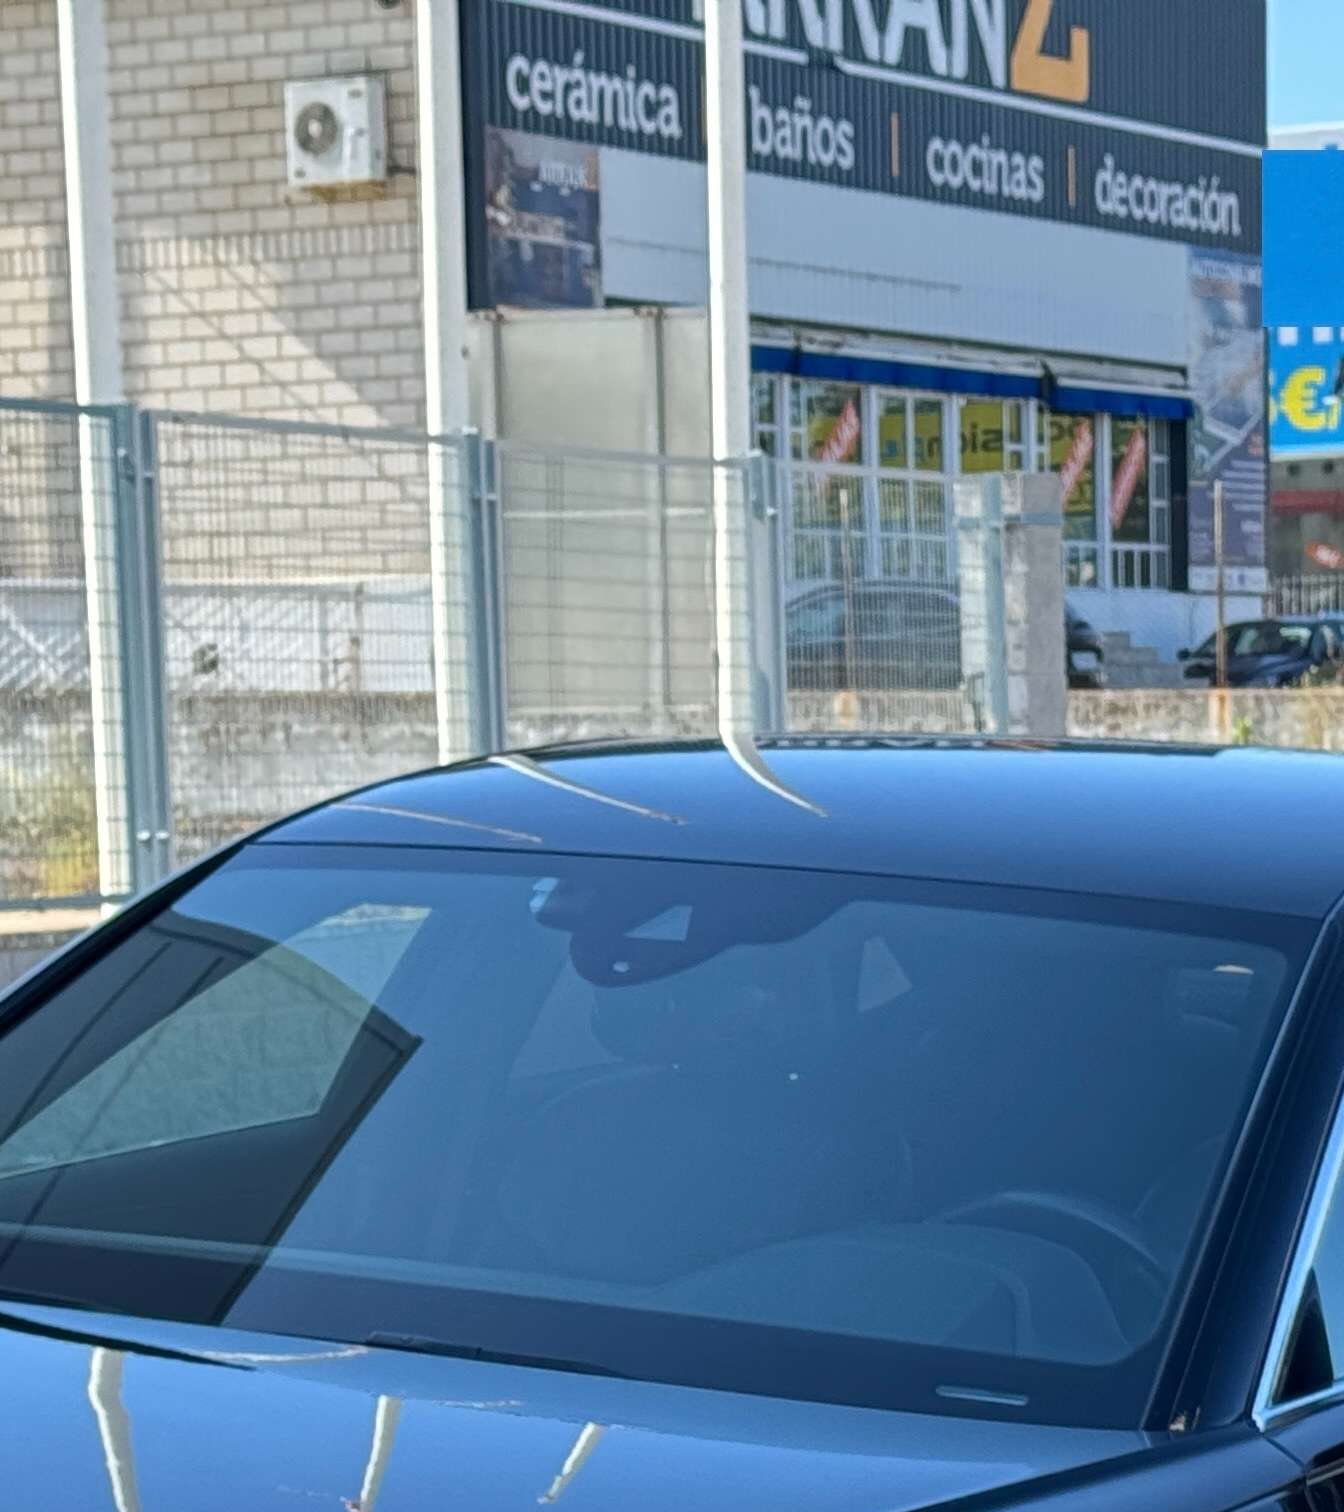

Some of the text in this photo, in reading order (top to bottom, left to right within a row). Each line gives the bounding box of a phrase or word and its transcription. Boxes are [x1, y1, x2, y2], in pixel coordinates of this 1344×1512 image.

[693, 0, 1090, 102] ANZ
[506, 50, 1242, 236] cerámica baños cocinas decoración
